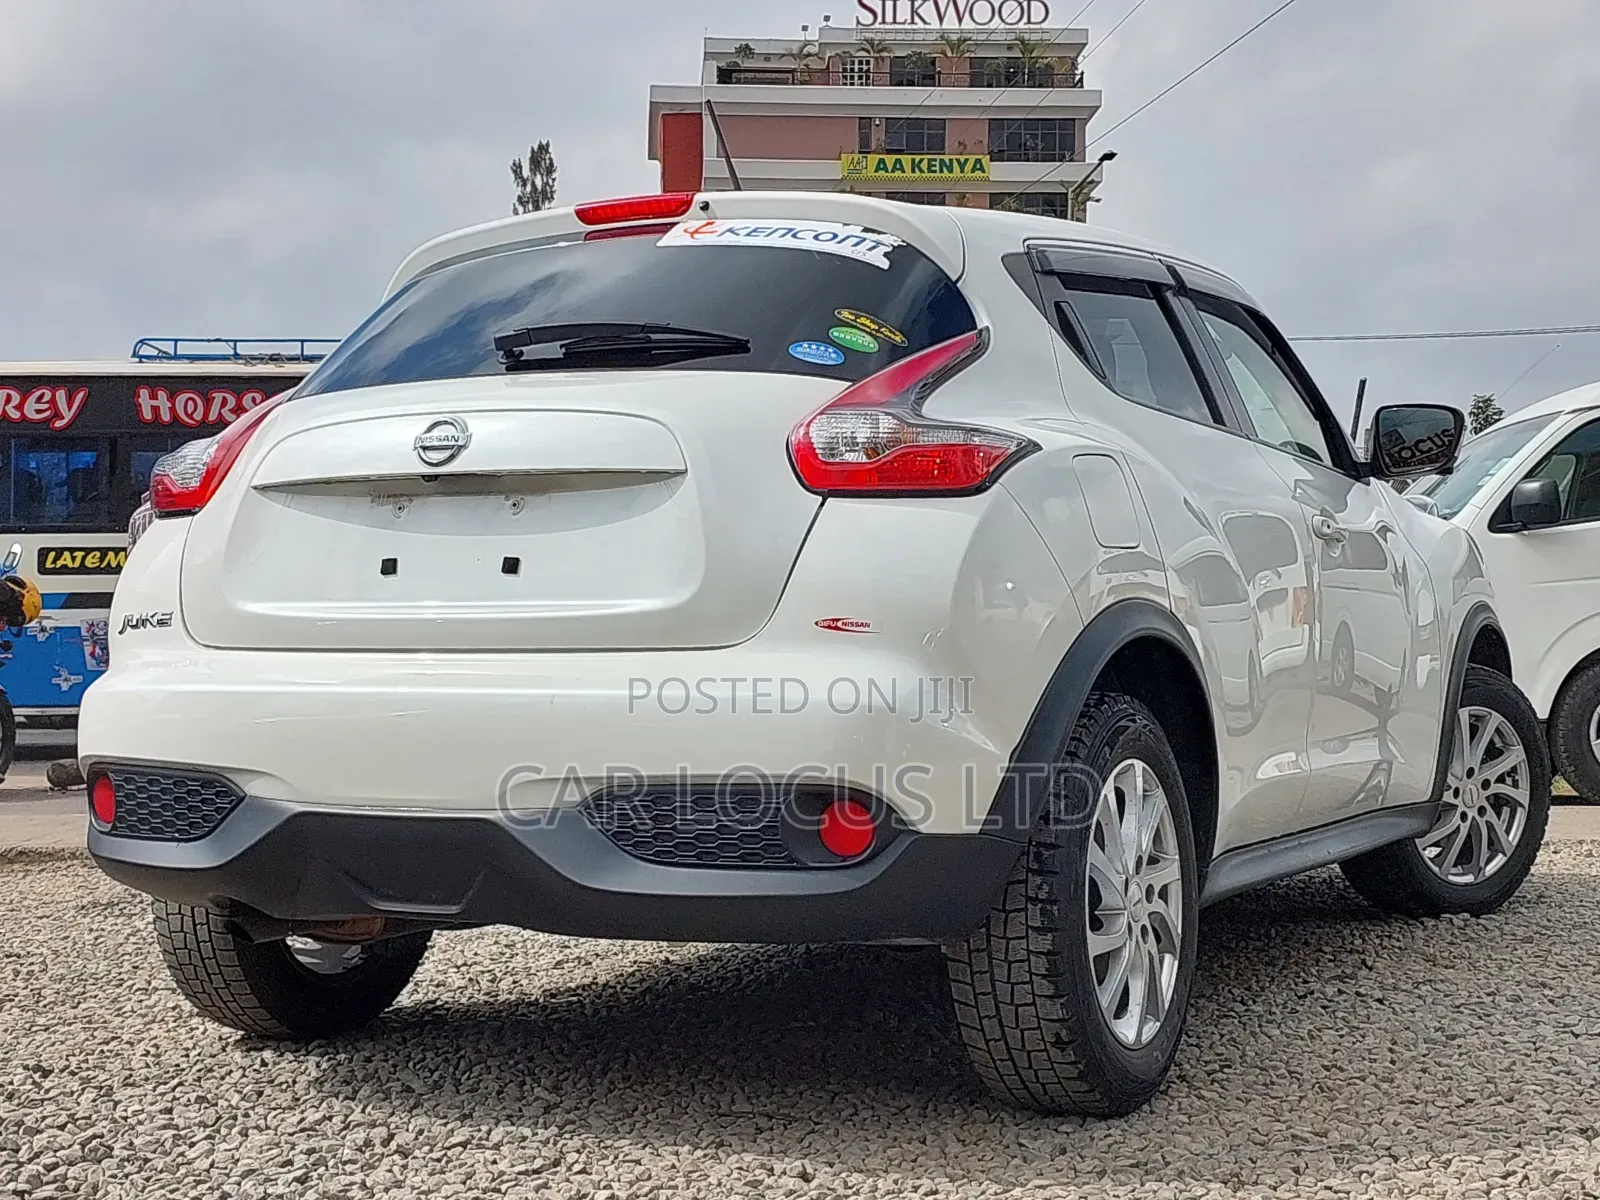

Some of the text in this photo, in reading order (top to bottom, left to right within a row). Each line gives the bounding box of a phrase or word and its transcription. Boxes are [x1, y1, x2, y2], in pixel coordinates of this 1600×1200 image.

[873, 157, 986, 174] AA KENYA
[0, 385, 89, 431] REY
[417, 434, 460, 445] NISSAN
[45, 551, 128, 569] LATEM
[117, 611, 174, 635] JUKE
